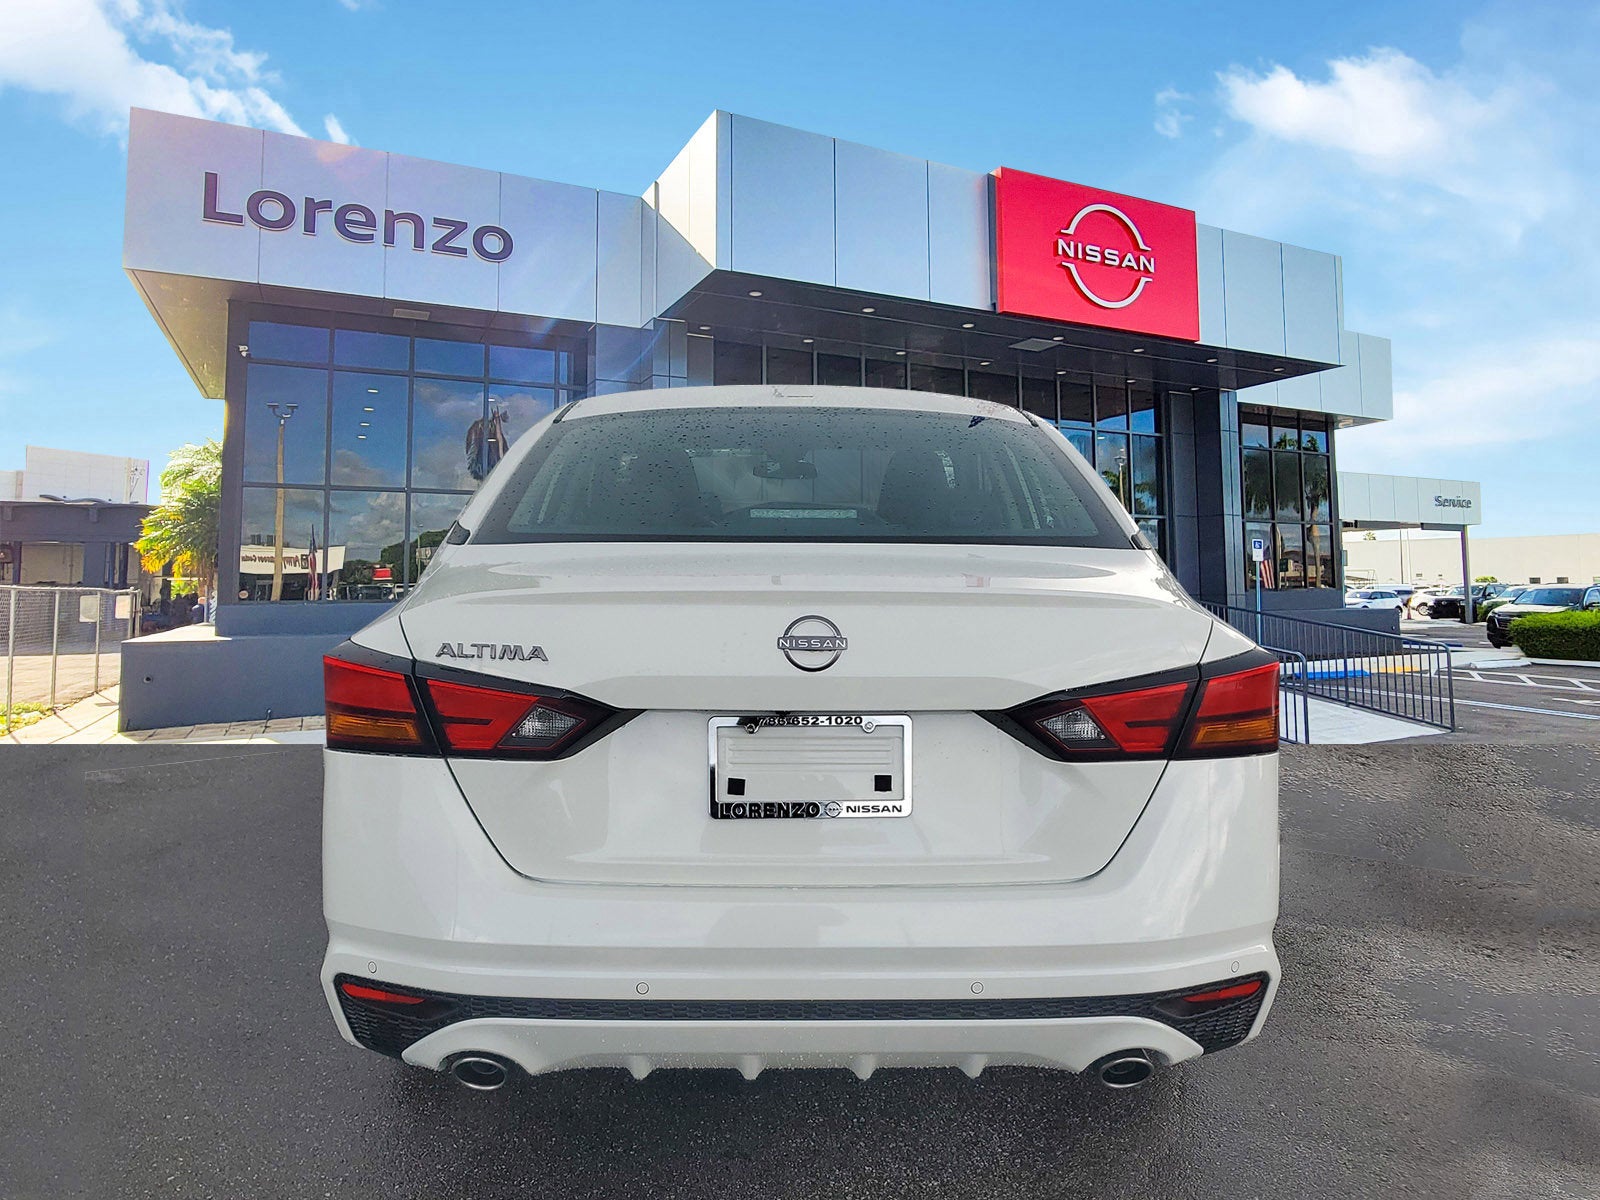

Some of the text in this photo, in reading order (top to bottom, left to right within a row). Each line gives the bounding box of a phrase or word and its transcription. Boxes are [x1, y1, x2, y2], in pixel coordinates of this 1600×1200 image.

[202, 171, 514, 262] Lorenzo
[1057, 238, 1155, 273] NISSAN
[1434, 495, 1472, 508] Service
[435, 642, 549, 661] ALTIMA
[779, 639, 846, 648] NISSAN
[758, 715, 863, 726] 786652-1020
[718, 801, 902, 818] LORENZO NISSAN
